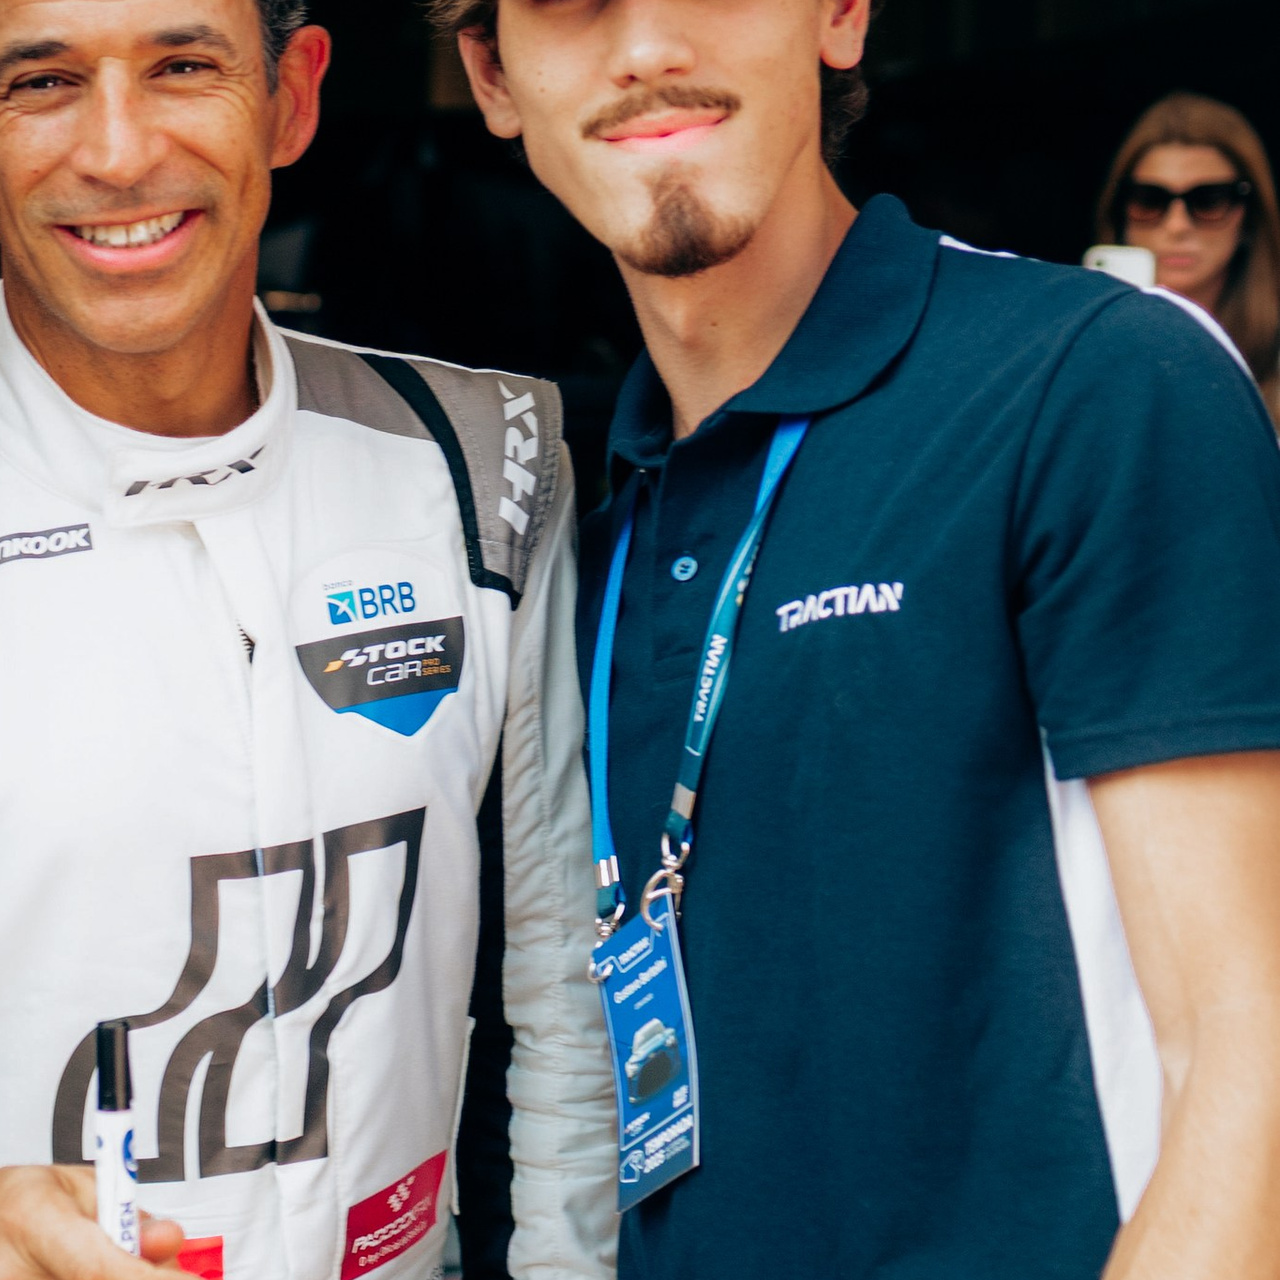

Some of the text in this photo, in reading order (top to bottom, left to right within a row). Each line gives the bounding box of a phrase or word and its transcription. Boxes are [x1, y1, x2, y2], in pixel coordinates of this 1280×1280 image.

[498, 380, 539, 536] HRX
[358, 581, 416, 620] BRB
[775, 581, 904, 633] TRACTIAN
[339, 634, 447, 668] STOCK
